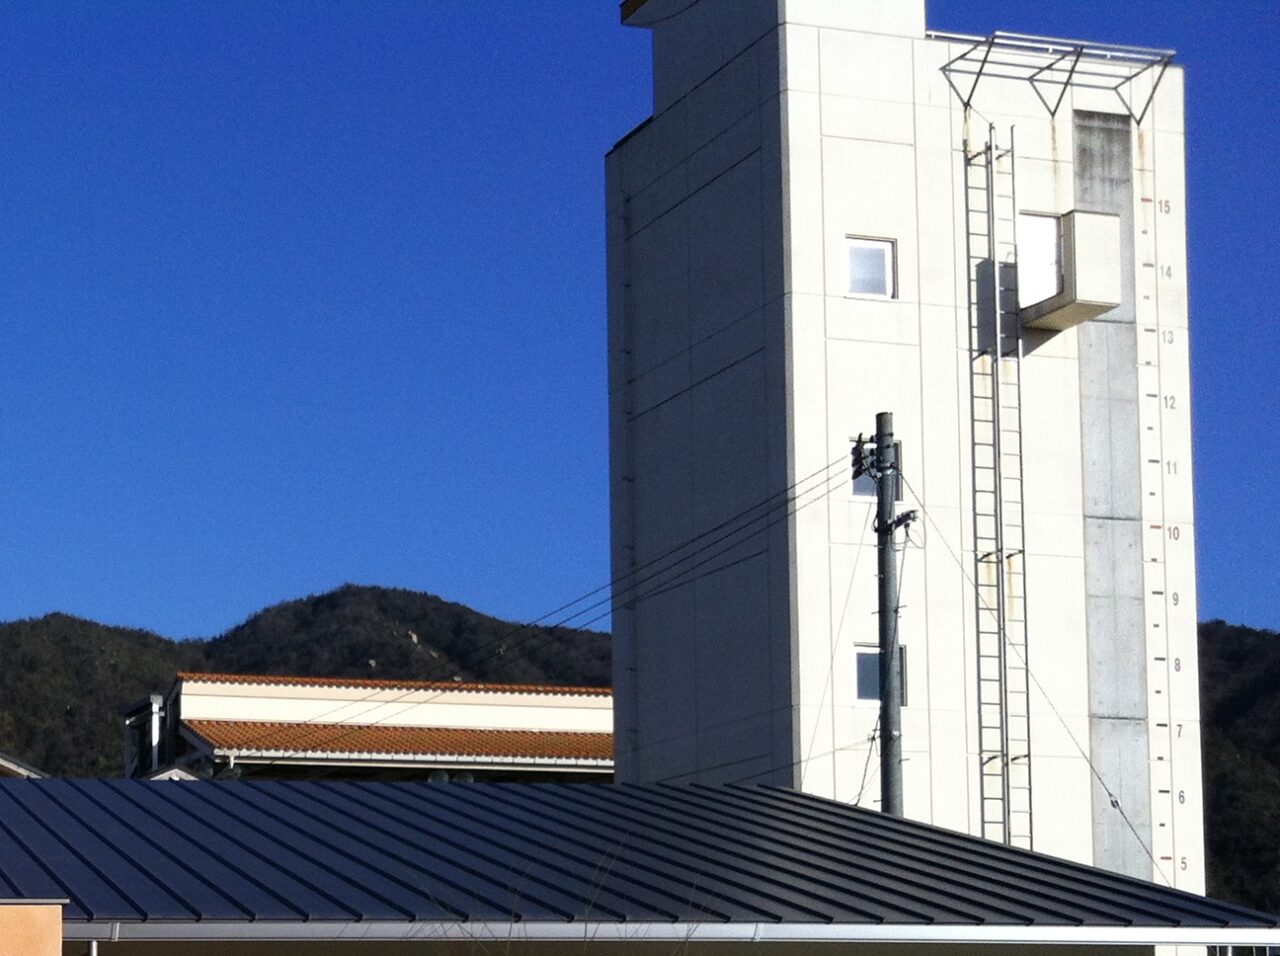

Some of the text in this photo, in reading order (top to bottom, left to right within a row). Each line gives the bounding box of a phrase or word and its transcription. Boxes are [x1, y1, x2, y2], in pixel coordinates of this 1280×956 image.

[1157, 199, 1171, 215] 15
[1159, 264, 1173, 280] 14
[1161, 329, 1174, 345] 13
[1163, 395, 1177, 410] 12
[1165, 460, 1178, 475] 11
[1167, 526, 1180, 541] 10
[1171, 592, 1179, 606] 9
[1174, 658, 1181, 672] 8
[1176, 724, 1183, 738] 7
[1178, 790, 1185, 804] 6
[1180, 857, 1187, 871] 5
